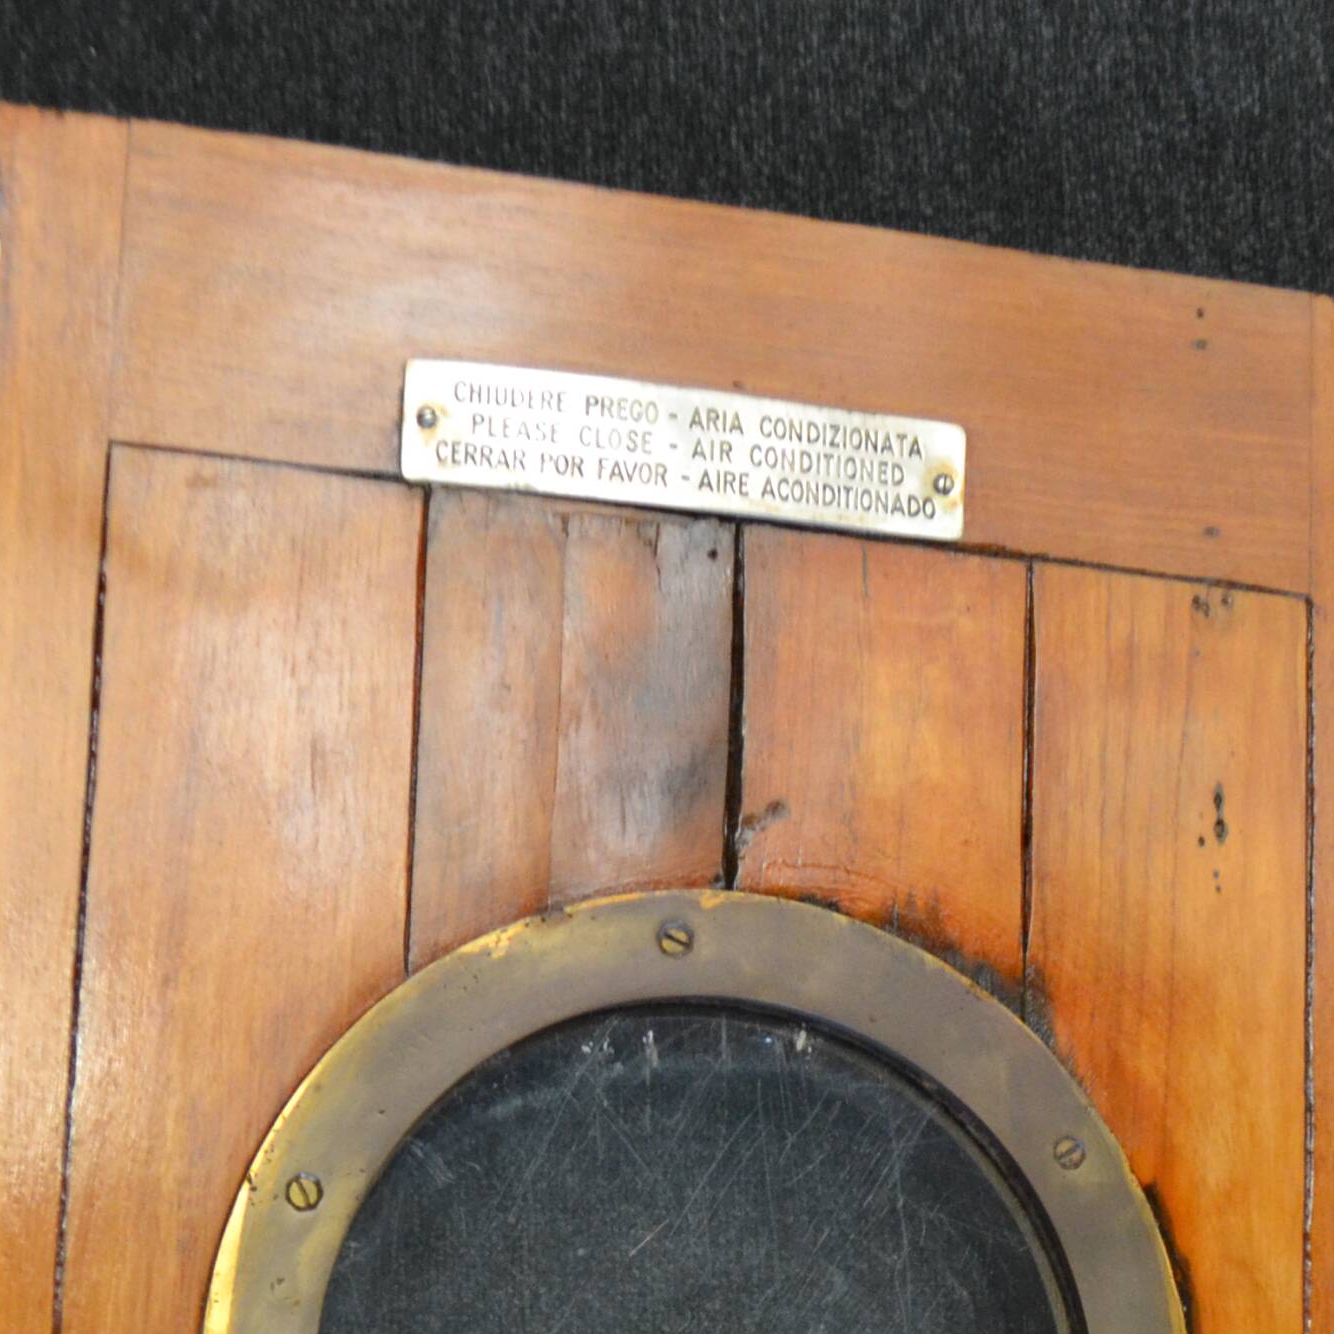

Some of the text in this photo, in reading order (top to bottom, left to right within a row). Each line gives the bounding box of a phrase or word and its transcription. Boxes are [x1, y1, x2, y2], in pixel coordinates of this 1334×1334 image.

[454, 381, 567, 412] CHIUDERE
[585, 394, 659, 425] PREGO
[689, 406, 744, 435] ARIA
[760, 415, 923, 460] CONDIZIONATA
[472, 413, 559, 444] PLEASE
[579, 425, 653, 454] CLOSE
[691, 438, 733, 463] AIR
[750, 444, 905, 486] CONDITIONED
[436, 440, 526, 471] CERRAR
[541, 452, 584, 479] POR
[597, 457, 668, 487] FAVOR
[698, 469, 750, 497] AIRE
[761, 476, 936, 519] ACONDITIONADO
